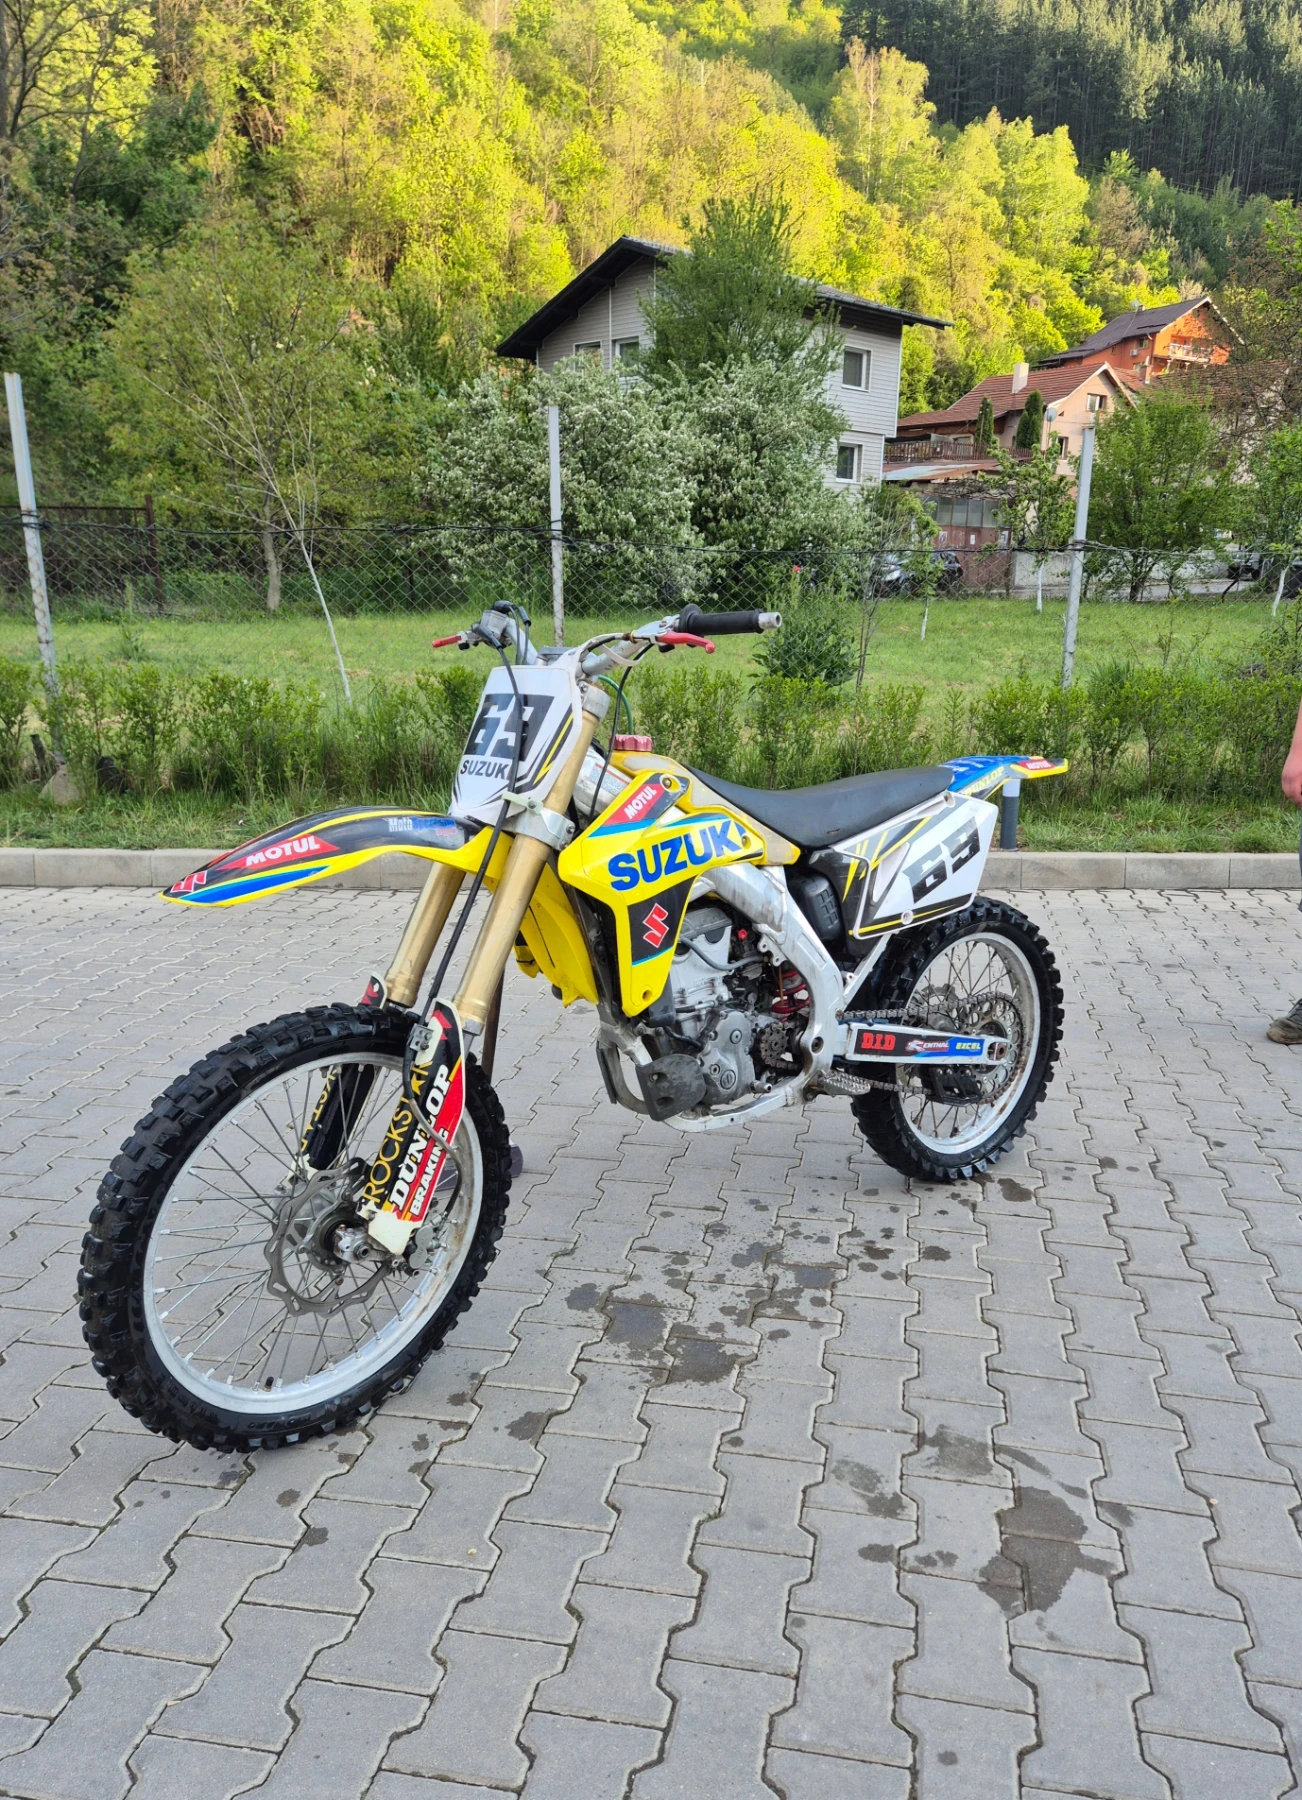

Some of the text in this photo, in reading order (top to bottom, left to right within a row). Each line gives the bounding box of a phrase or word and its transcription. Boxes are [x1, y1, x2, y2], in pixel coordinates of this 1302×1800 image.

[464, 693, 555, 762] 69
[623, 785, 658, 820] MOTUL
[245, 835, 320, 867] MOTUL
[901, 816, 980, 904] 69
[861, 1032, 896, 1051] D.I.D
[389, 1064, 451, 1211] DUNLOP
[409, 1128, 450, 1216] BRAKING
